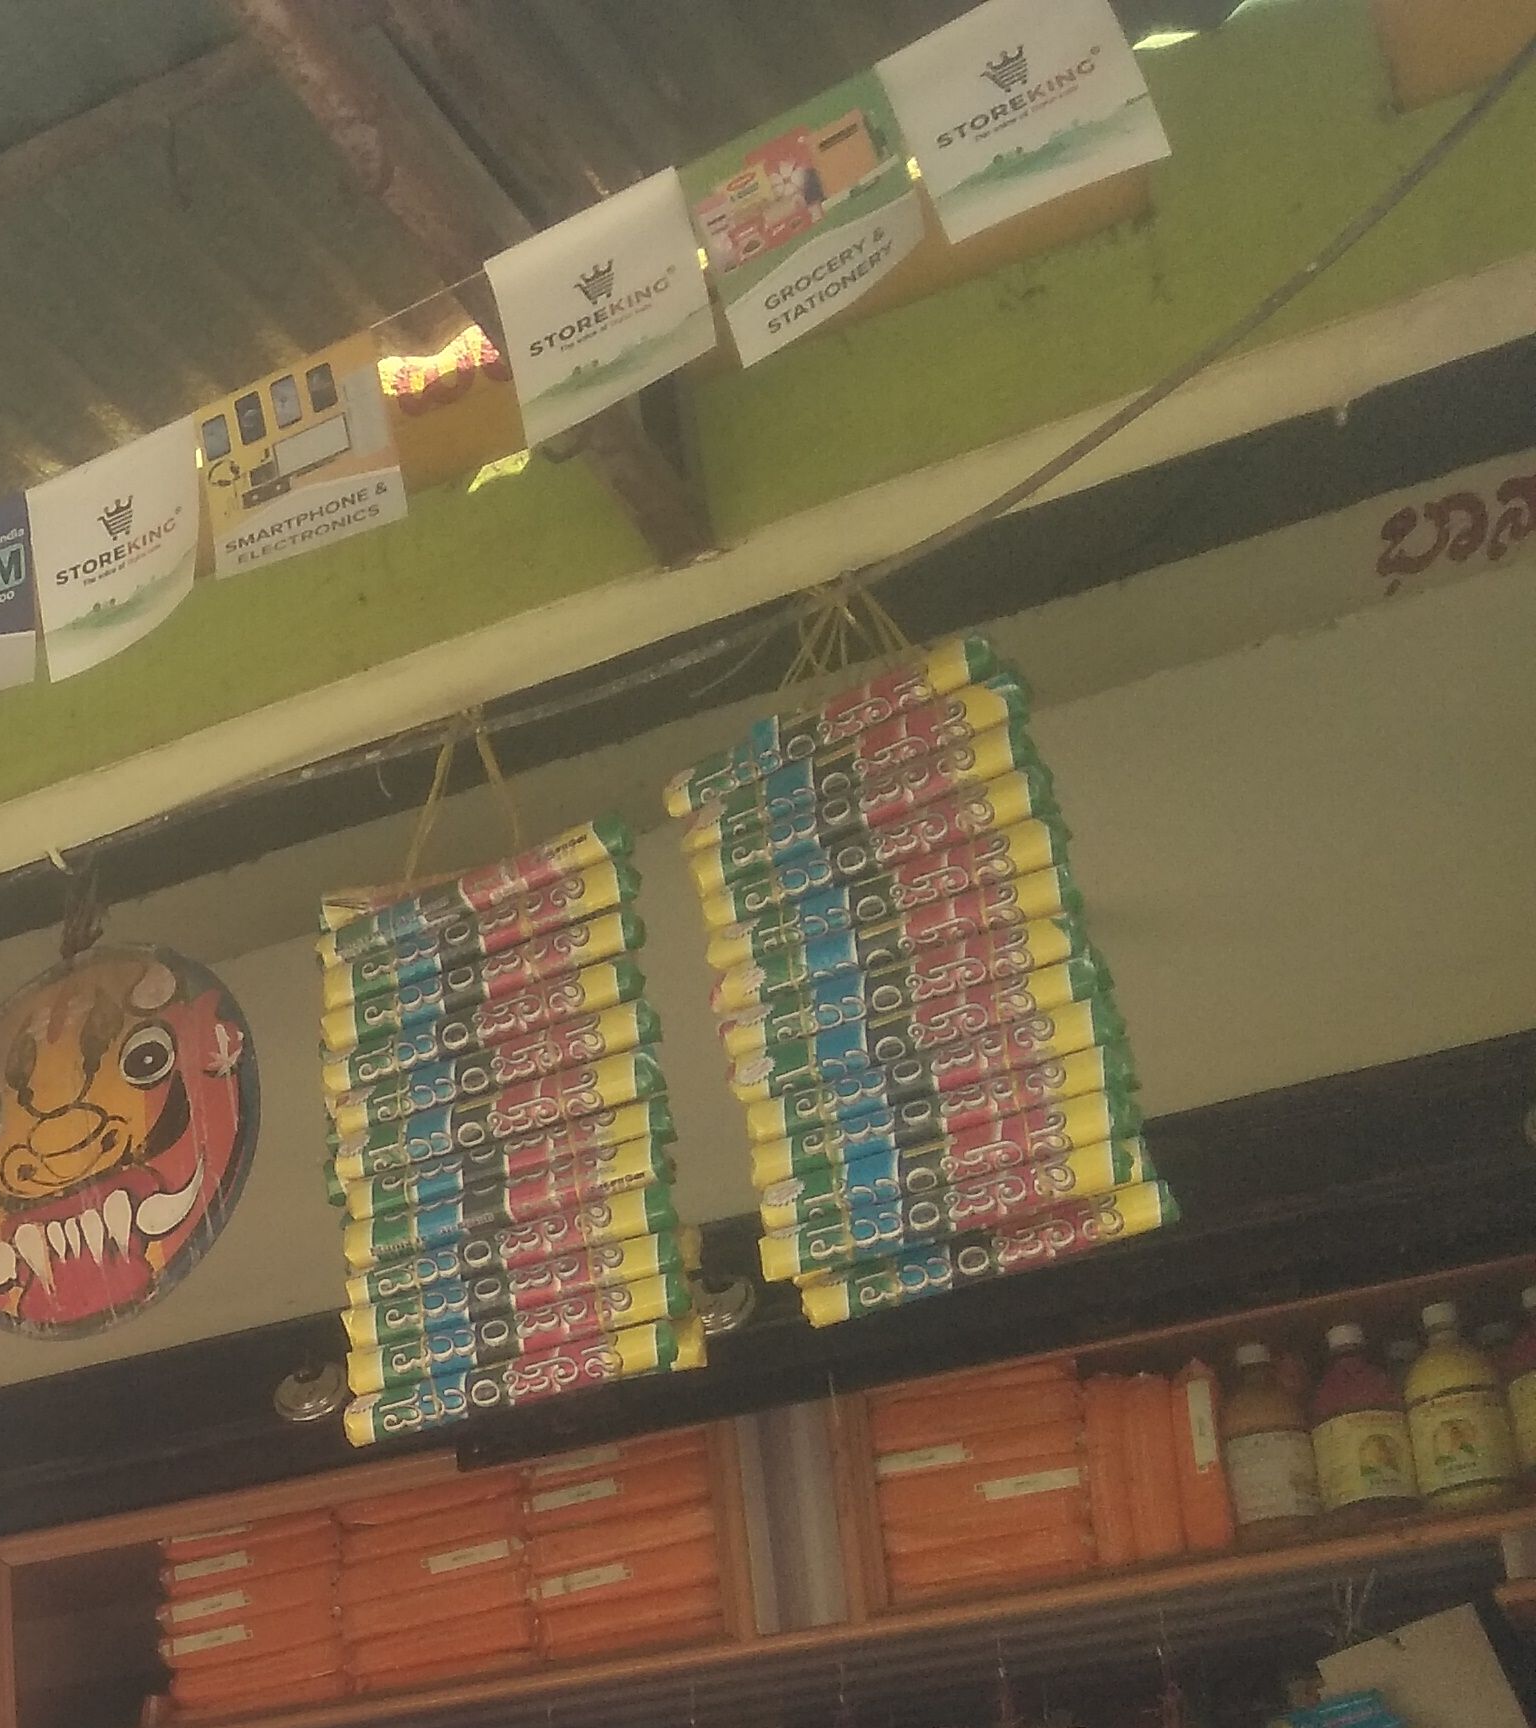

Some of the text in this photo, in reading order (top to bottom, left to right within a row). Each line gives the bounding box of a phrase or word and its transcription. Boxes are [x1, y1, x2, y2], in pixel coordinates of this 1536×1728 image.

[936, 57, 1097, 150] STOREKING
[764, 226, 887, 311] GROCERY &
[767, 242, 894, 334] STATIONERY
[530, 271, 672, 358] STOREKING
[55, 516, 177, 587] STOREKING
[225, 481, 387, 554] SMARTPHONE &
[238, 504, 381, 564] ELECTRONICS
